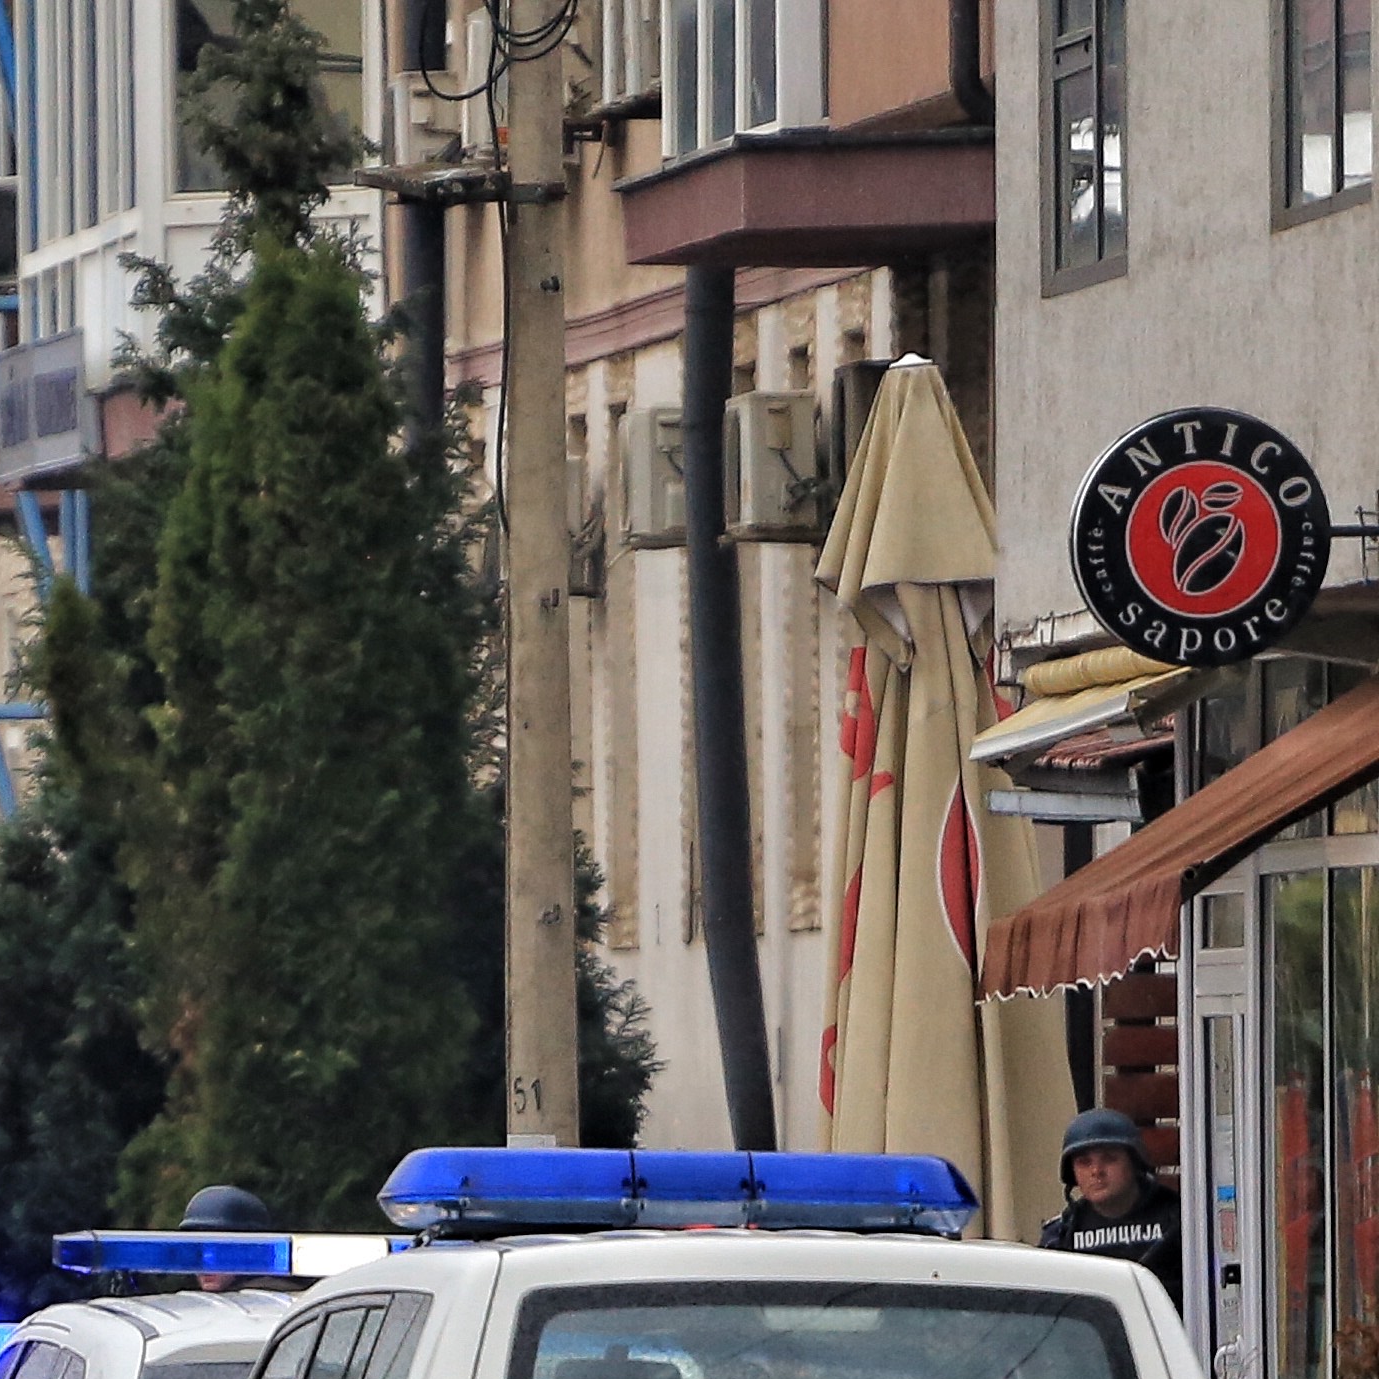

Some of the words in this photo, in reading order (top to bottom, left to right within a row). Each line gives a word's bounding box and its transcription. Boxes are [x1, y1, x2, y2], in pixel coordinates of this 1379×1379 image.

[1097, 420, 1312, 515] ANTICO
[1119, 597, 1289, 661] sapore
[1073, 1222, 1164, 1250] ПОЛИЦИЈА
